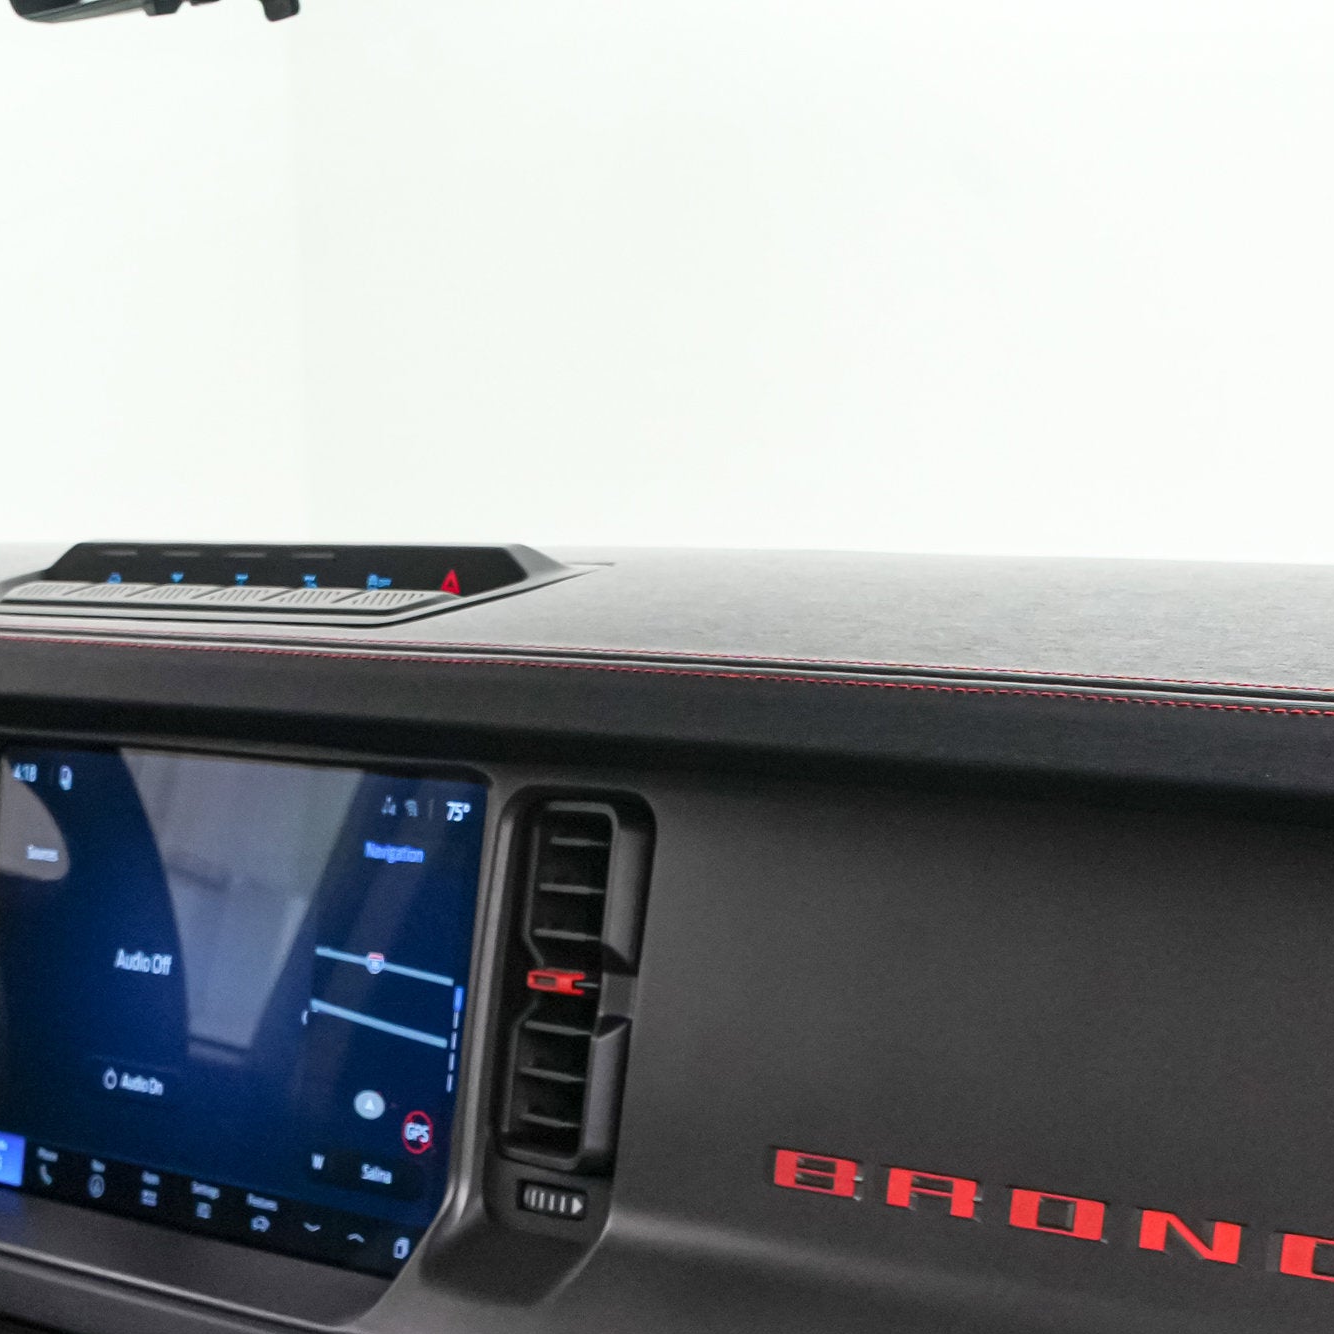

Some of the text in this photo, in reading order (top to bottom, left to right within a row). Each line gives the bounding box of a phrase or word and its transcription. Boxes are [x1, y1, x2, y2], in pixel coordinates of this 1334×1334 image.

[364, 841, 424, 864] Navigation
[114, 948, 172, 976] Audio Off
[119, 1072, 149, 1093] Audio
[404, 1121, 430, 1143] GPS
